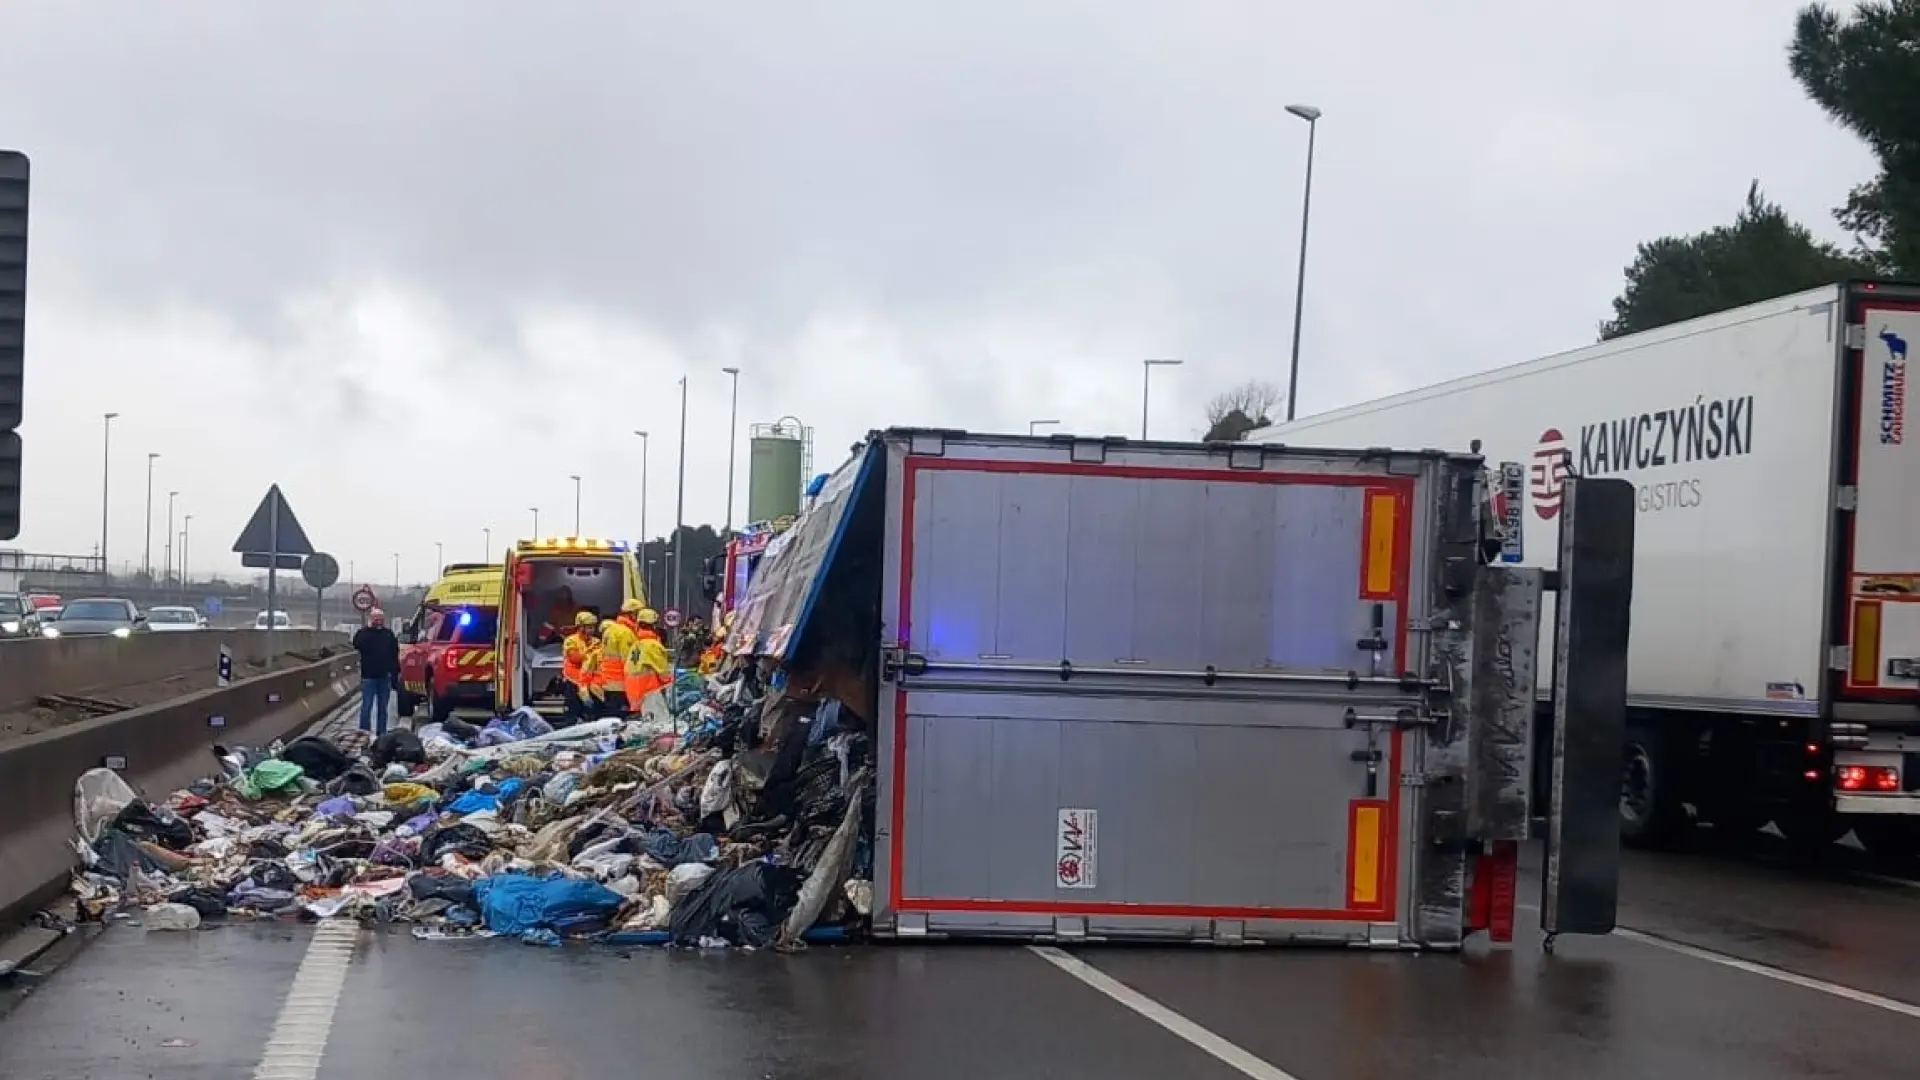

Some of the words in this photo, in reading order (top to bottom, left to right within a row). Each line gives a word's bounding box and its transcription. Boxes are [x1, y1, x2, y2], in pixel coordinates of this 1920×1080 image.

[1579, 394, 1754, 479] KAWCZYŃSKI
[1881, 362, 1894, 445] SCHMITZ
[1635, 479, 1702, 513] GISTICS
